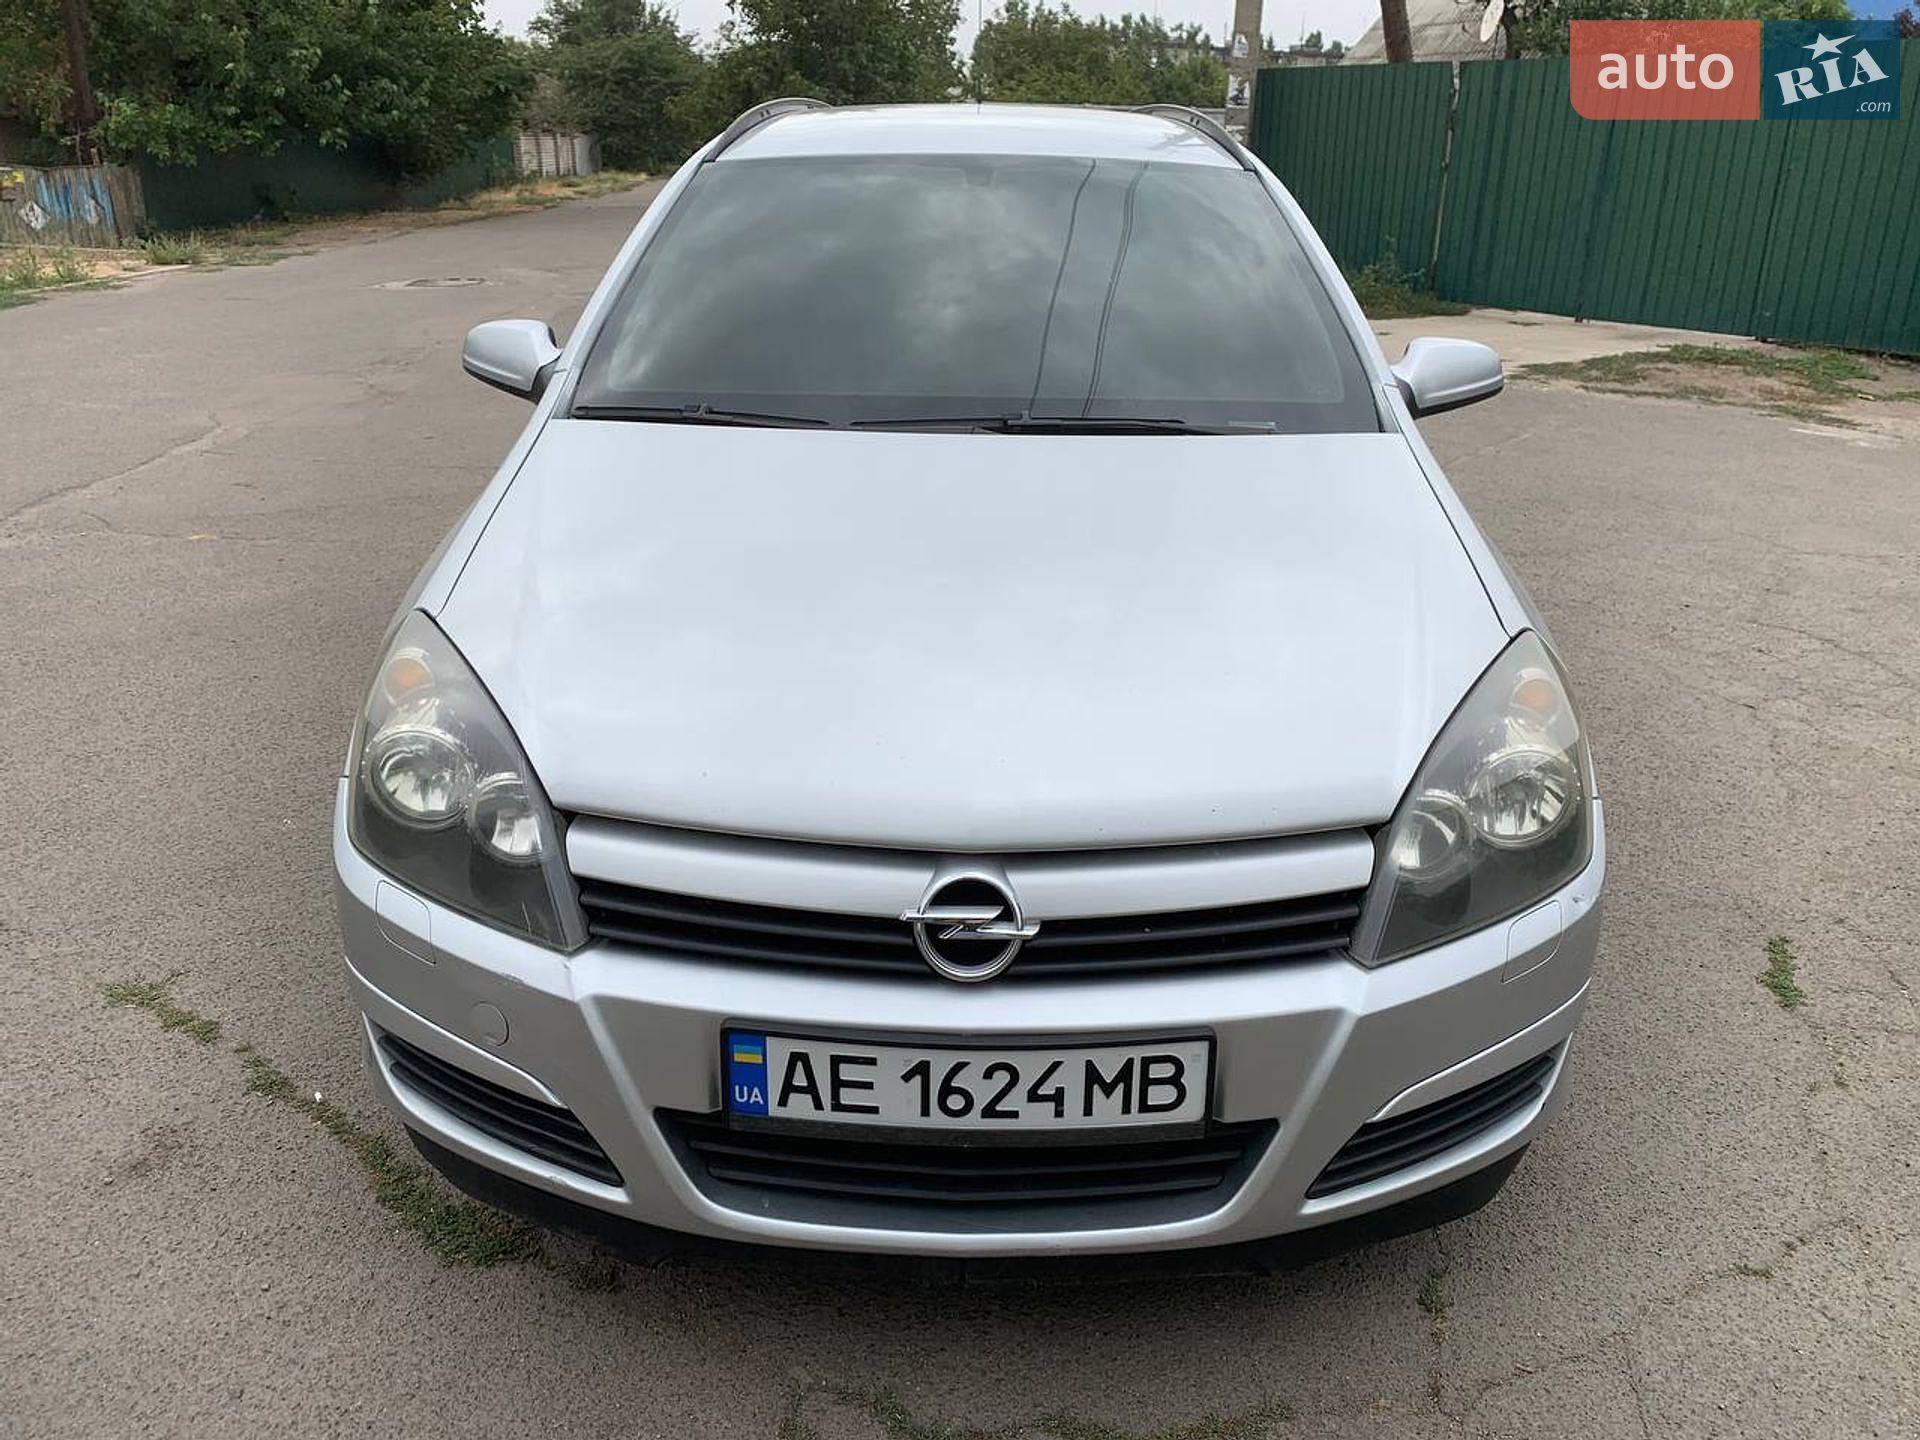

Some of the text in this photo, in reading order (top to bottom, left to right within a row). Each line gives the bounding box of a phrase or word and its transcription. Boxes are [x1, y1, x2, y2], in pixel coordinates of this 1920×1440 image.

[734, 1084, 764, 1105] UA
[777, 1051, 1188, 1119] AE 1624 MB
